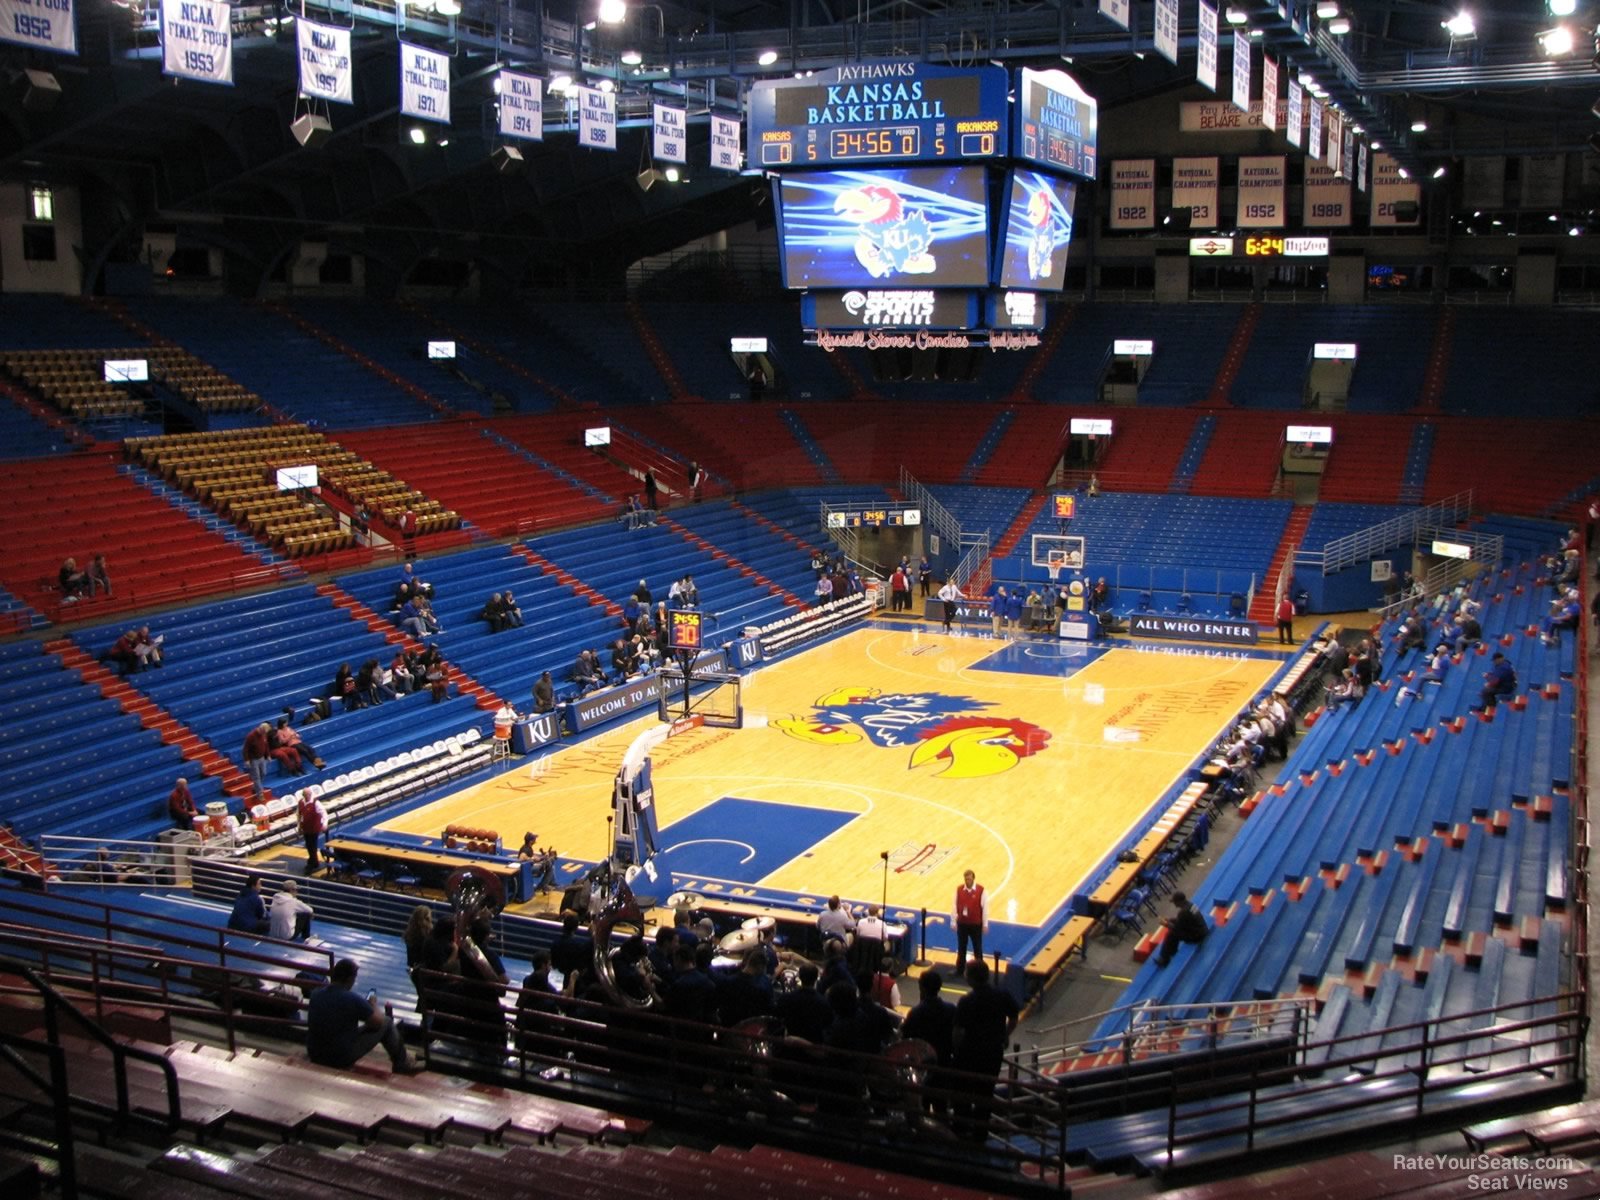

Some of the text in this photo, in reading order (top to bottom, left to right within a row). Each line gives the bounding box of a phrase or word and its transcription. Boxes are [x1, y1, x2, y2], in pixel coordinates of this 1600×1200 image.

[181, 3, 214, 26] NCAA
[13, 13, 52, 40] 1952
[168, 21, 228, 48] FINAL FOUR
[311, 30, 337, 51] NCAA
[184, 51, 214, 73] 1953
[302, 47, 327, 65] FINAL
[414, 54, 438, 74] NCAA
[405, 70, 448, 92] FINAL FOUR
[836, 62, 915, 82] JAYHAWKS
[315, 73, 337, 93] 1957
[511, 79, 532, 97] NCAA
[588, 93, 607, 110] NCAA
[827, 81, 922, 105] KANSAS
[417, 94, 436, 113] 1971
[503, 94, 540, 112] FINAL FOUR
[1047, 88, 1077, 118] KANSAS
[662, 111, 678, 125] NCAA
[807, 101, 945, 125] BASKETBALL
[1040, 106, 1081, 138] BASKETBALL
[1200, 114, 1241, 129] BEWARE
[513, 116, 531, 132] 1974
[718, 122, 733, 137] NCAA
[895, 128, 916, 136] PERIOD
[956, 121, 999, 134] ARKANSAS
[762, 131, 791, 142] KANSAS
[836, 131, 892, 155] 34:56
[902, 136, 912, 154] 0
[981, 134, 991, 154] 0
[780, 144, 790, 162] 0
[1116, 170, 1150, 179] NATIONAL
[1178, 168, 1213, 177] NATIONAL
[1244, 167, 1280, 176] NATIONAL
[1112, 181, 1153, 190] CHAMPIONS
[1173, 179, 1217, 189] CHAMPIONS
[1239, 178, 1283, 188] CHAMPIONS
[1117, 206, 1147, 220] 1922
[1245, 205, 1276, 218] 1952
[1311, 203, 1343, 217] 1988
[1245, 239, 1282, 255] 6:24
[866, 298, 935, 316] SPORTS
[817, 329, 866, 352] Russell
[866, 329, 915, 350] Stover
[915, 328, 970, 350] Candies
[673, 613, 700, 626] 34:56
[1135, 619, 1251, 637] ALL WHO ENTER
[677, 624, 697, 645] 30
[741, 641, 757, 662] KU
[580, 694, 627, 722] WELCOME
[629, 690, 643, 703] TO
[528, 716, 552, 744] KU
